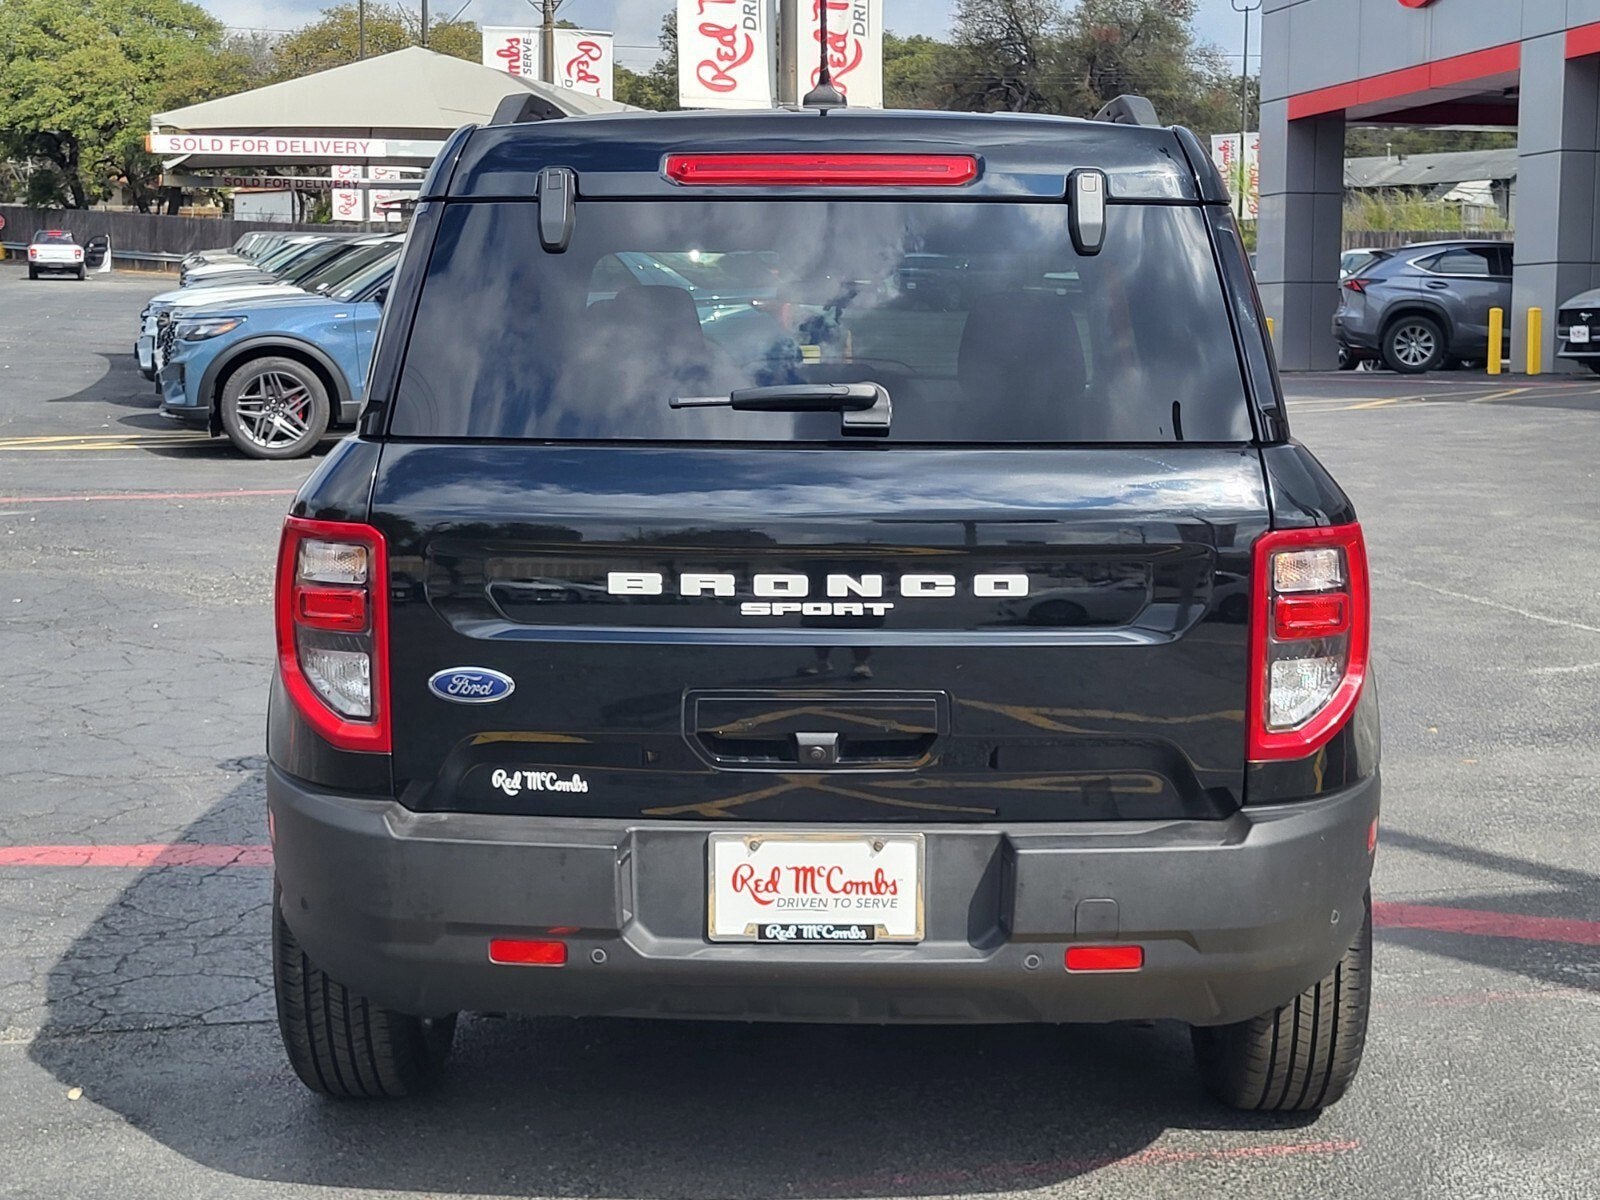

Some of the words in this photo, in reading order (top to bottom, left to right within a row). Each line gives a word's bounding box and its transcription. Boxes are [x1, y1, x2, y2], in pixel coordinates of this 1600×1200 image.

[522, 37, 533, 75] SERVE
[566, 41, 603, 83] Red
[696, 22, 754, 92] Red
[169, 138, 224, 152] SOLD
[230, 139, 270, 152] FOR
[275, 140, 371, 154] DELIVERY
[223, 177, 261, 188] SOLD
[264, 178, 292, 189] FOR
[295, 179, 360, 190] DELIVERY
[338, 193, 358, 216] Red
[608, 572, 1030, 597] BRONCO
[740, 602, 894, 616] SPORT
[447, 674, 494, 696] Ford
[491, 768, 523, 797] Red
[523, 770, 589, 793] McCombs
[731, 863, 782, 906] Red
[786, 865, 899, 896] McCombs
[776, 898, 829, 909] DRIVEN
[833, 898, 852, 909] TO
[856, 898, 898, 909] SERVE
[765, 924, 799, 940] Red
[798, 924, 867, 940] McCombs
